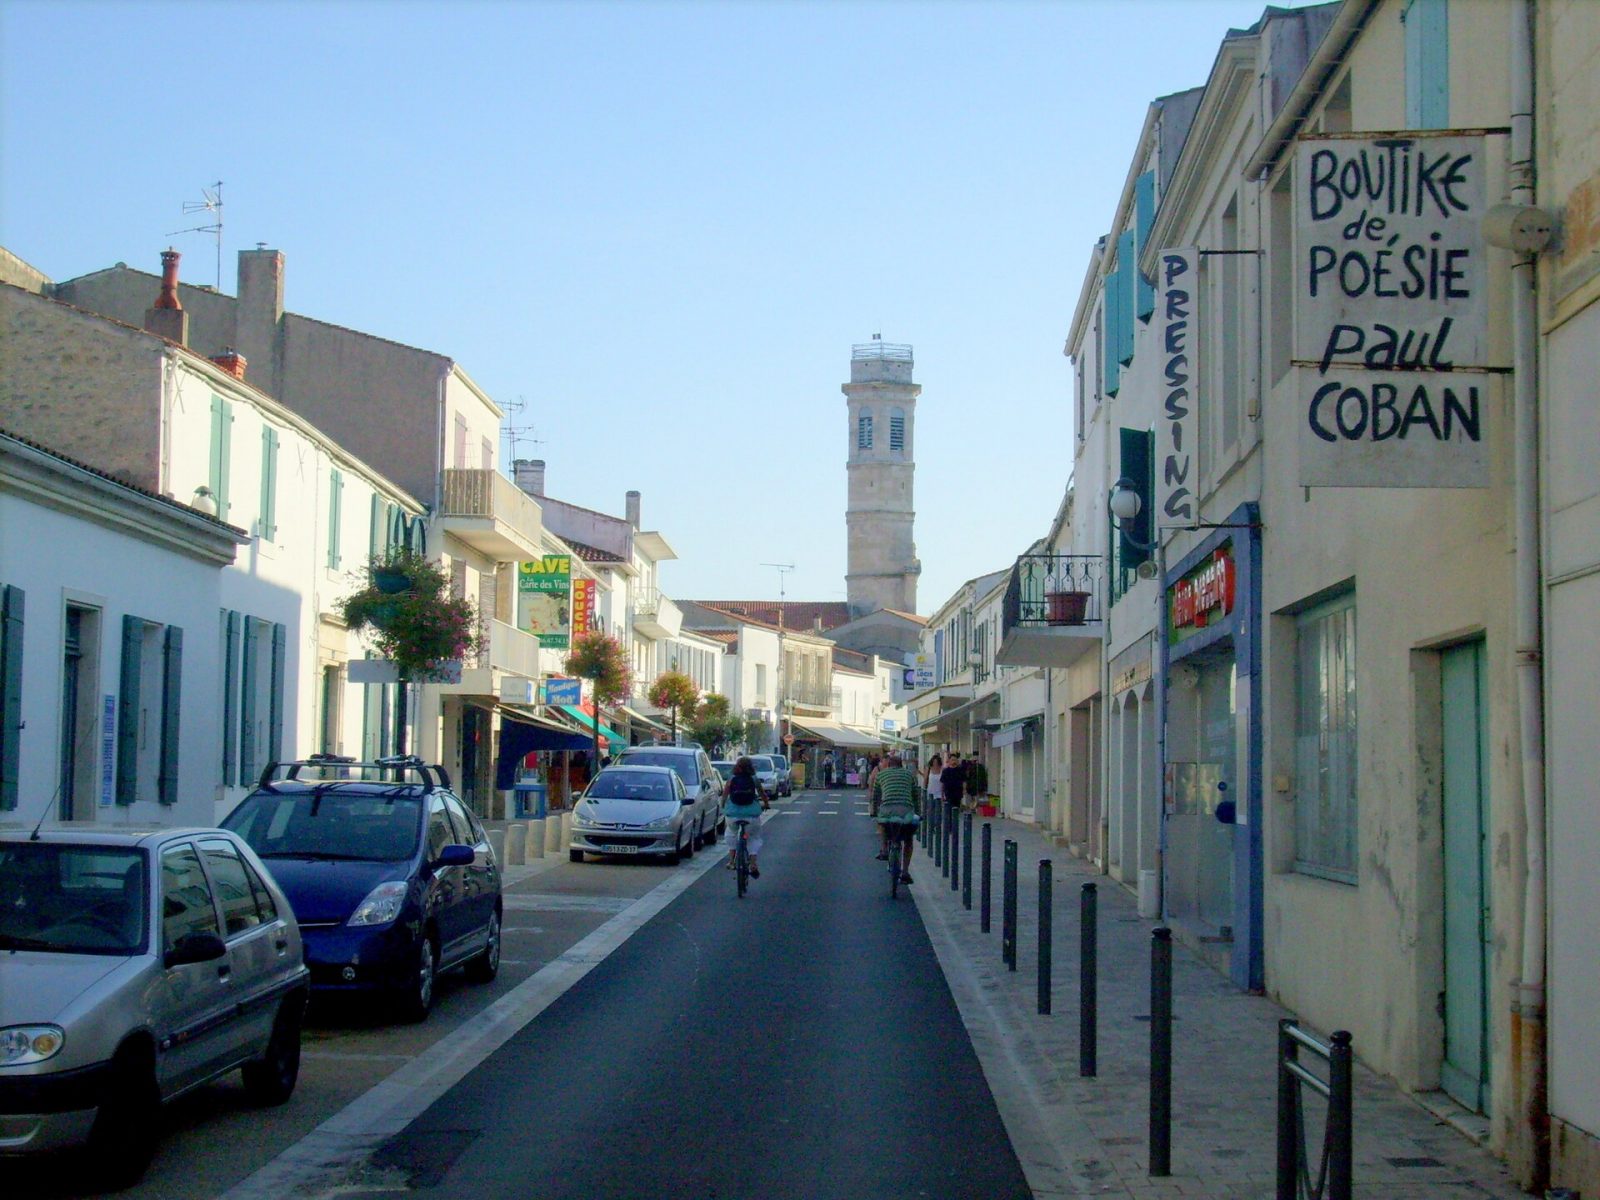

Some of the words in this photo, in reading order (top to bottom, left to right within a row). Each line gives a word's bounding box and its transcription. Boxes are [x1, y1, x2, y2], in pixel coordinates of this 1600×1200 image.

[1343, 211, 1388, 241] de
[1162, 253, 1193, 520] PRESSING
[1308, 381, 1481, 443] COBAN
[519, 559, 569, 574] CAVE
[519, 578, 539, 589] Carte
[539, 578, 553, 589] des
[553, 579, 570, 590] Vins
